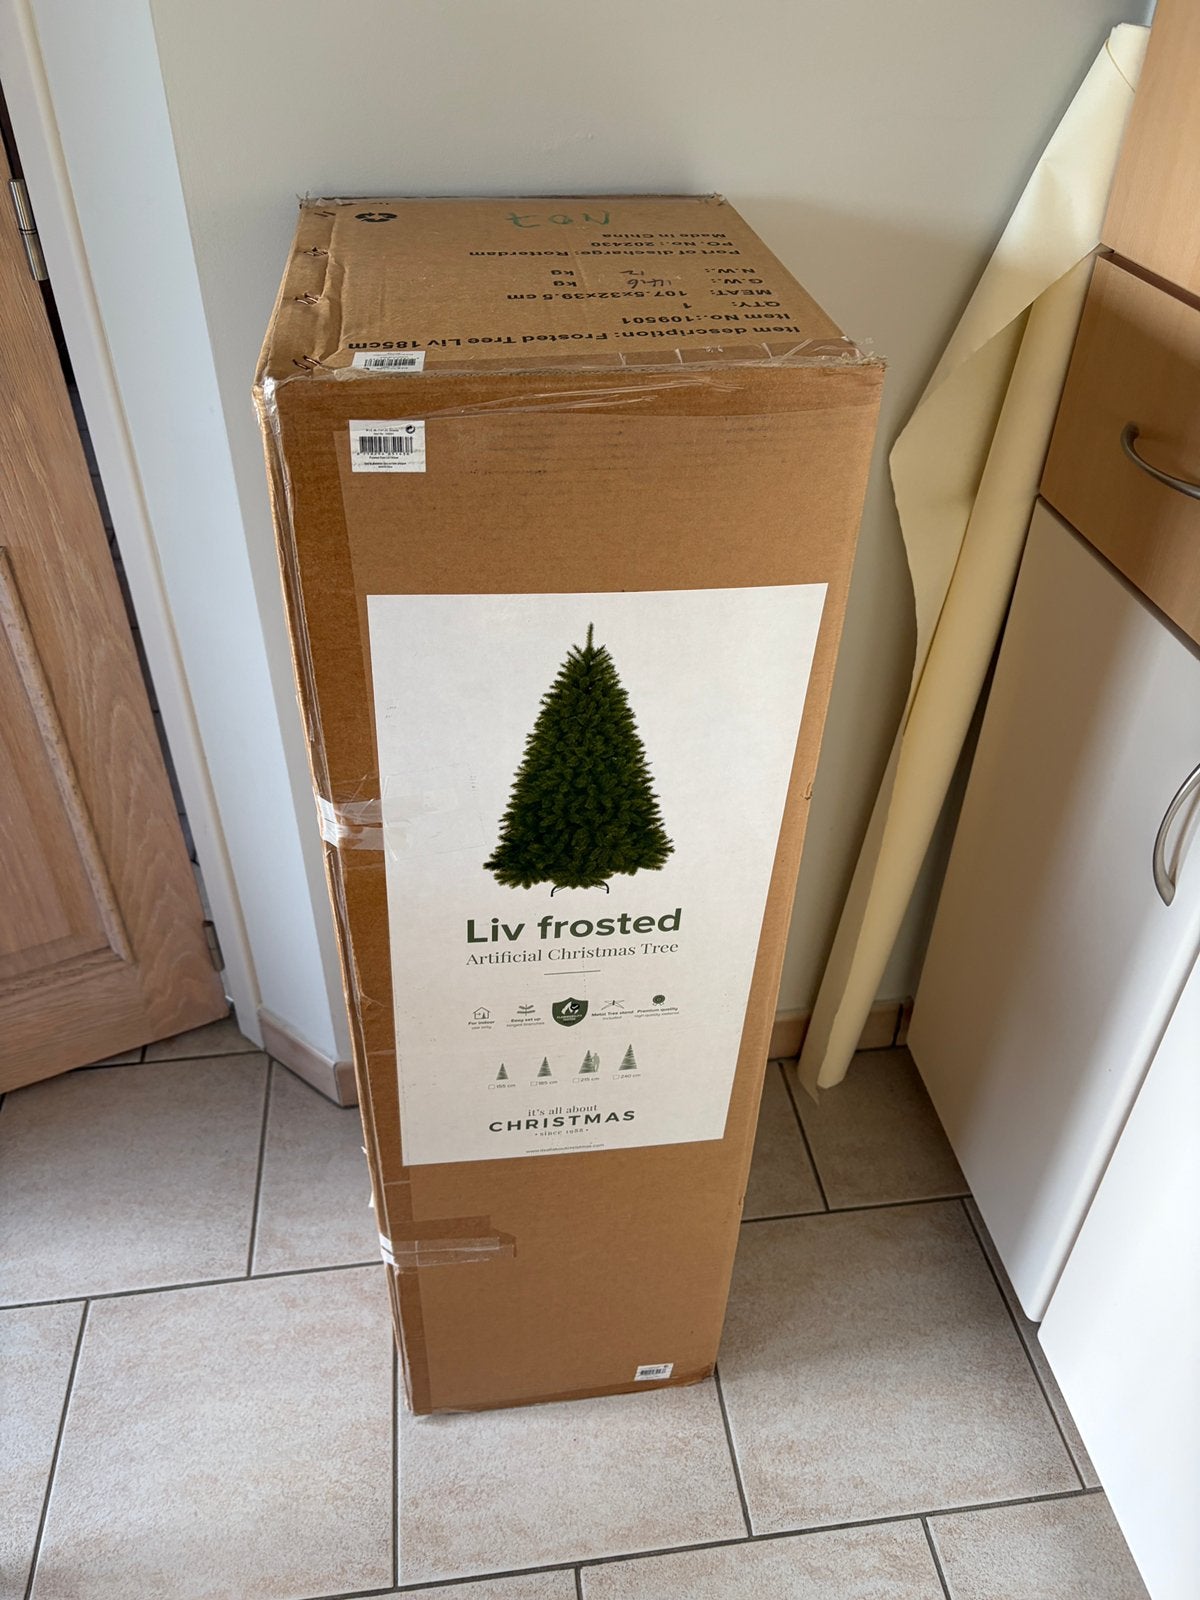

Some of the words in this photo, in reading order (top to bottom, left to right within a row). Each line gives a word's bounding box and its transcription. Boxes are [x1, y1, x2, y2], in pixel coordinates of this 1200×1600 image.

[468, 250, 570, 258] Rotterdam
[550, 269, 575, 278] kg
[553, 279, 578, 288] kg
[507, 293, 538, 301] cm
[542, 289, 688, 301] 107.5x32x39.5
[709, 289, 773, 297] MEAT:
[745, 312, 791, 321] Item
[614, 327, 748, 340] description:
[753, 325, 801, 334] Item
[427, 337, 461, 348] Liv
[468, 335, 517, 347] Tree
[522, 332, 608, 344] Frosted
[347, 340, 422, 351] 185cm
[467, 917, 526, 943] Liv
[537, 907, 682, 940] frosted
[466, 949, 542, 966] Artificial
[548, 945, 636, 962] Christmas
[640, 942, 679, 955] Tree
[528, 1108, 545, 1117] it's
[548, 1106, 563, 1115] all
[565, 1104, 599, 1114] about
[488, 1110, 637, 1133] CHRISTMAS
